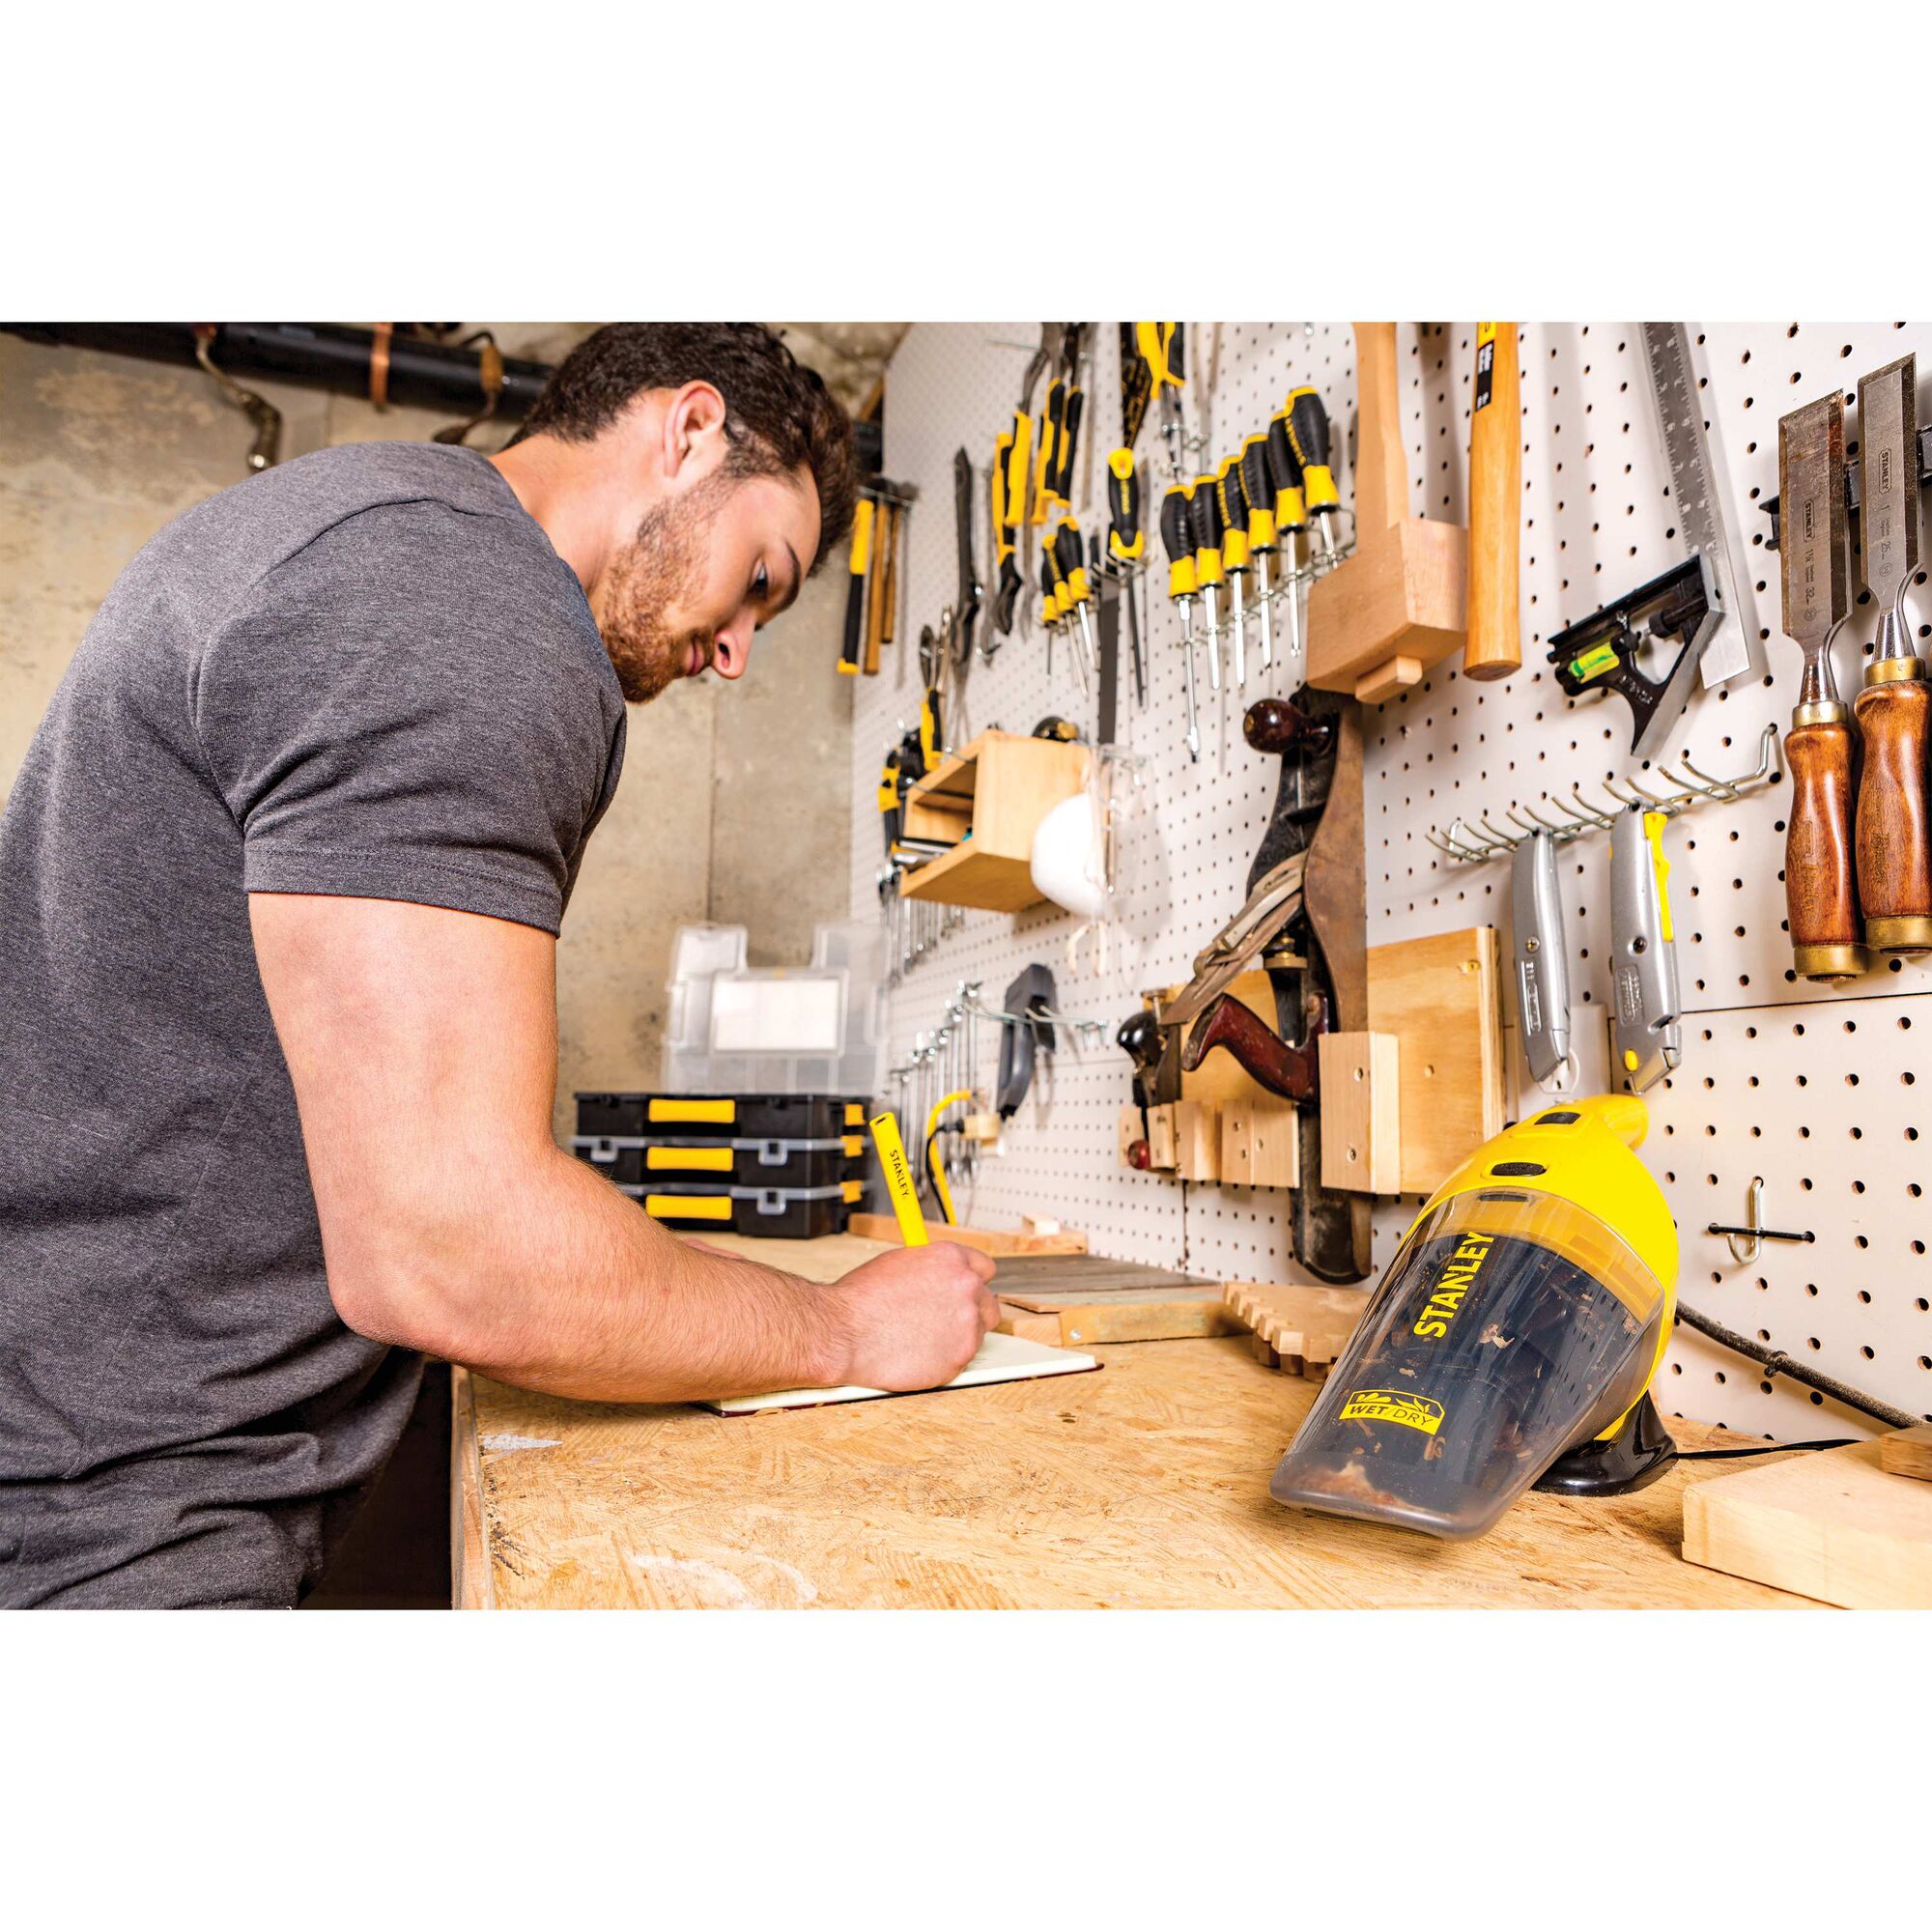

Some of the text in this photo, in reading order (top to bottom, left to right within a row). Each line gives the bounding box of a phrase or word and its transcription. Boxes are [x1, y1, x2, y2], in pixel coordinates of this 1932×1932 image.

[1804, 502, 1813, 539] STANLEY
[890, 1149, 910, 1196] STANLEY
[1413, 1231, 1494, 1338] STANLEY
[1350, 1406, 1434, 1426] WET/DRY
